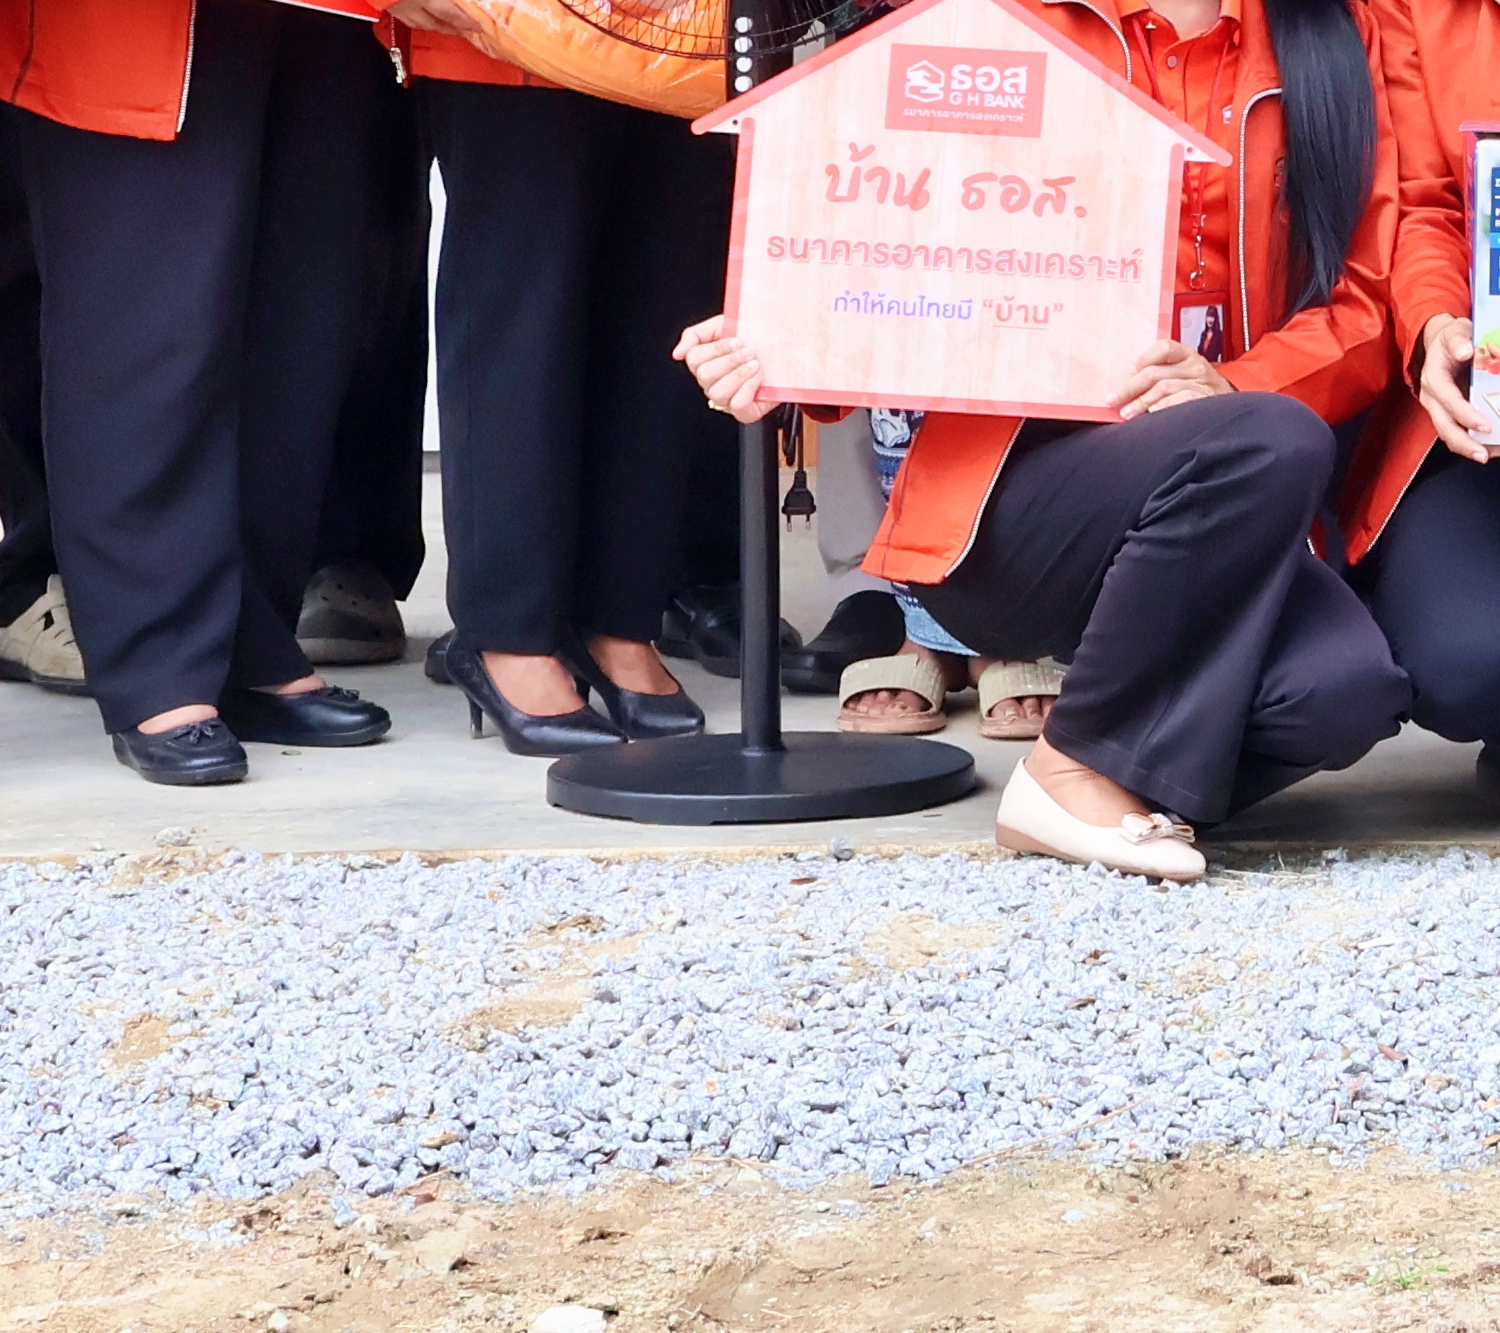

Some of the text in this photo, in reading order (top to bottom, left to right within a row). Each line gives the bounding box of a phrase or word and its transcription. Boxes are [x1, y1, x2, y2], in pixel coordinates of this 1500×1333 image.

[950, 64, 1029, 94] ธอส
[903, 108, 1026, 123] ธนาคารอาคารสงเคราะห์
[949, 91, 1026, 110] G H BANK
[825, 141, 1088, 218] บ้าน ธอส.
[766, 235, 1143, 283] ธนาคารอาคารสงเคราะห์
[833, 290, 973, 321] ทำให้คนไทยมี
